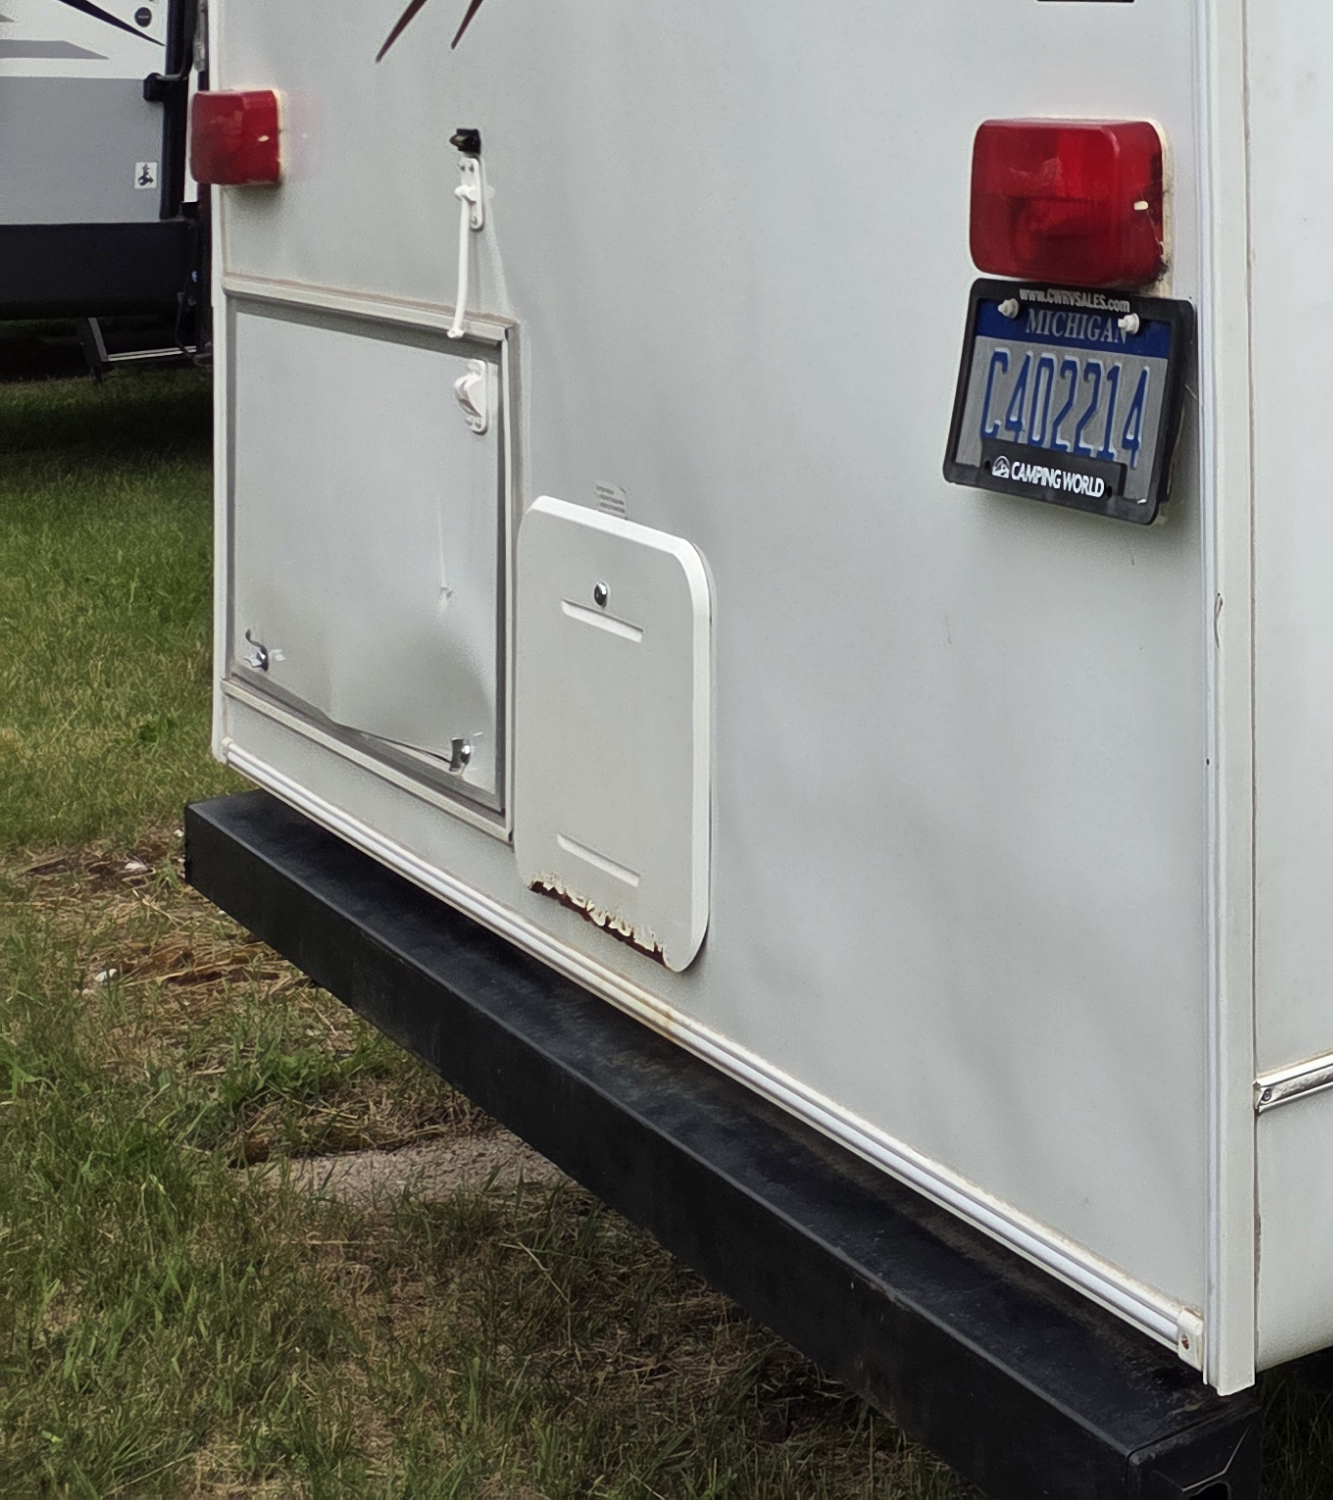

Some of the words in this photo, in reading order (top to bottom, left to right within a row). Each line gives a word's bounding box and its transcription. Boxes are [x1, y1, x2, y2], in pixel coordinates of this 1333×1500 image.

[980, 347, 1150, 469] C402214
[1011, 461, 1062, 489] CAMPING
[1062, 471, 1105, 498] WORLD
